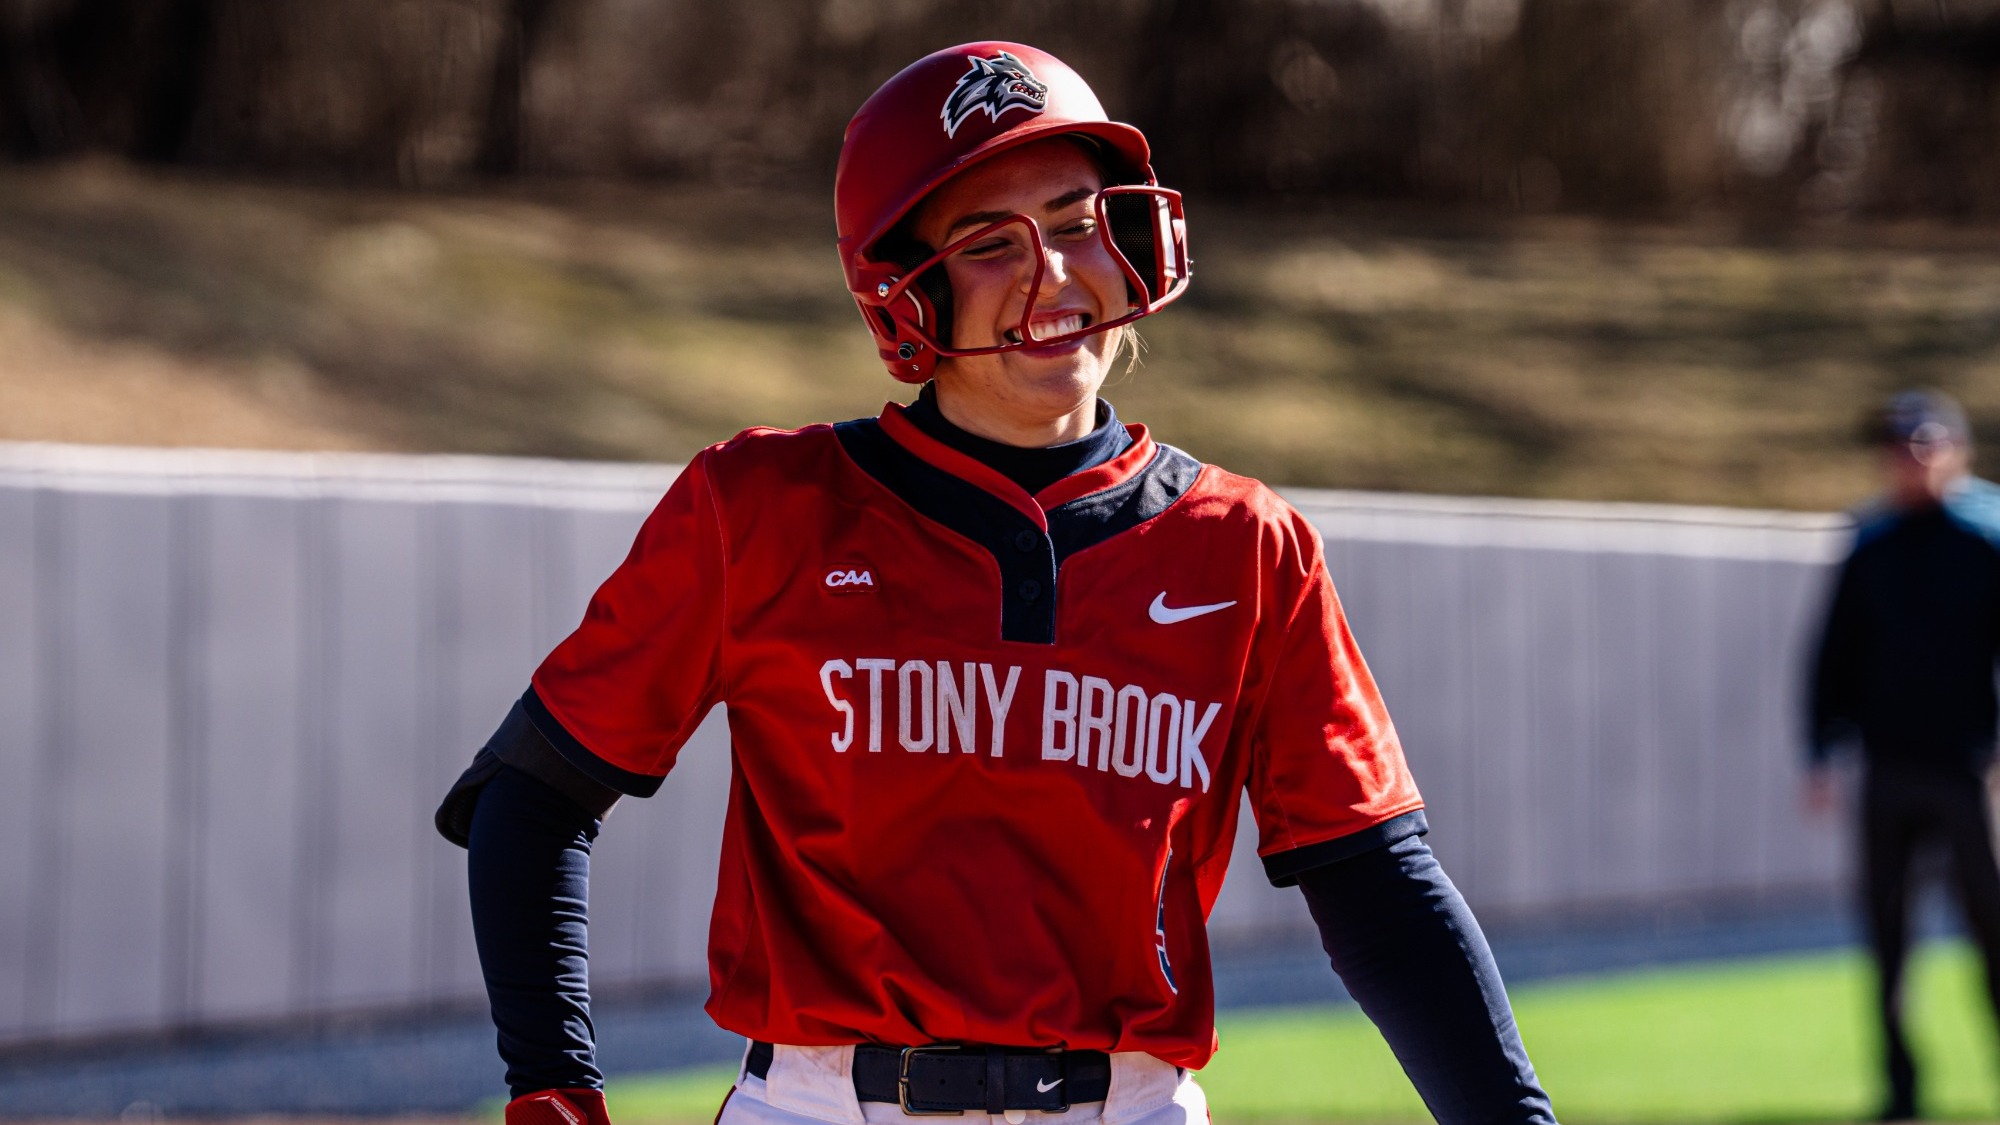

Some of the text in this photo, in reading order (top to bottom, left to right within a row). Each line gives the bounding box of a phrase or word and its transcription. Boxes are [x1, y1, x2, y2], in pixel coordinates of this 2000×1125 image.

[825, 569, 874, 587] CAA
[819, 658, 1223, 794] STONY BROOK
